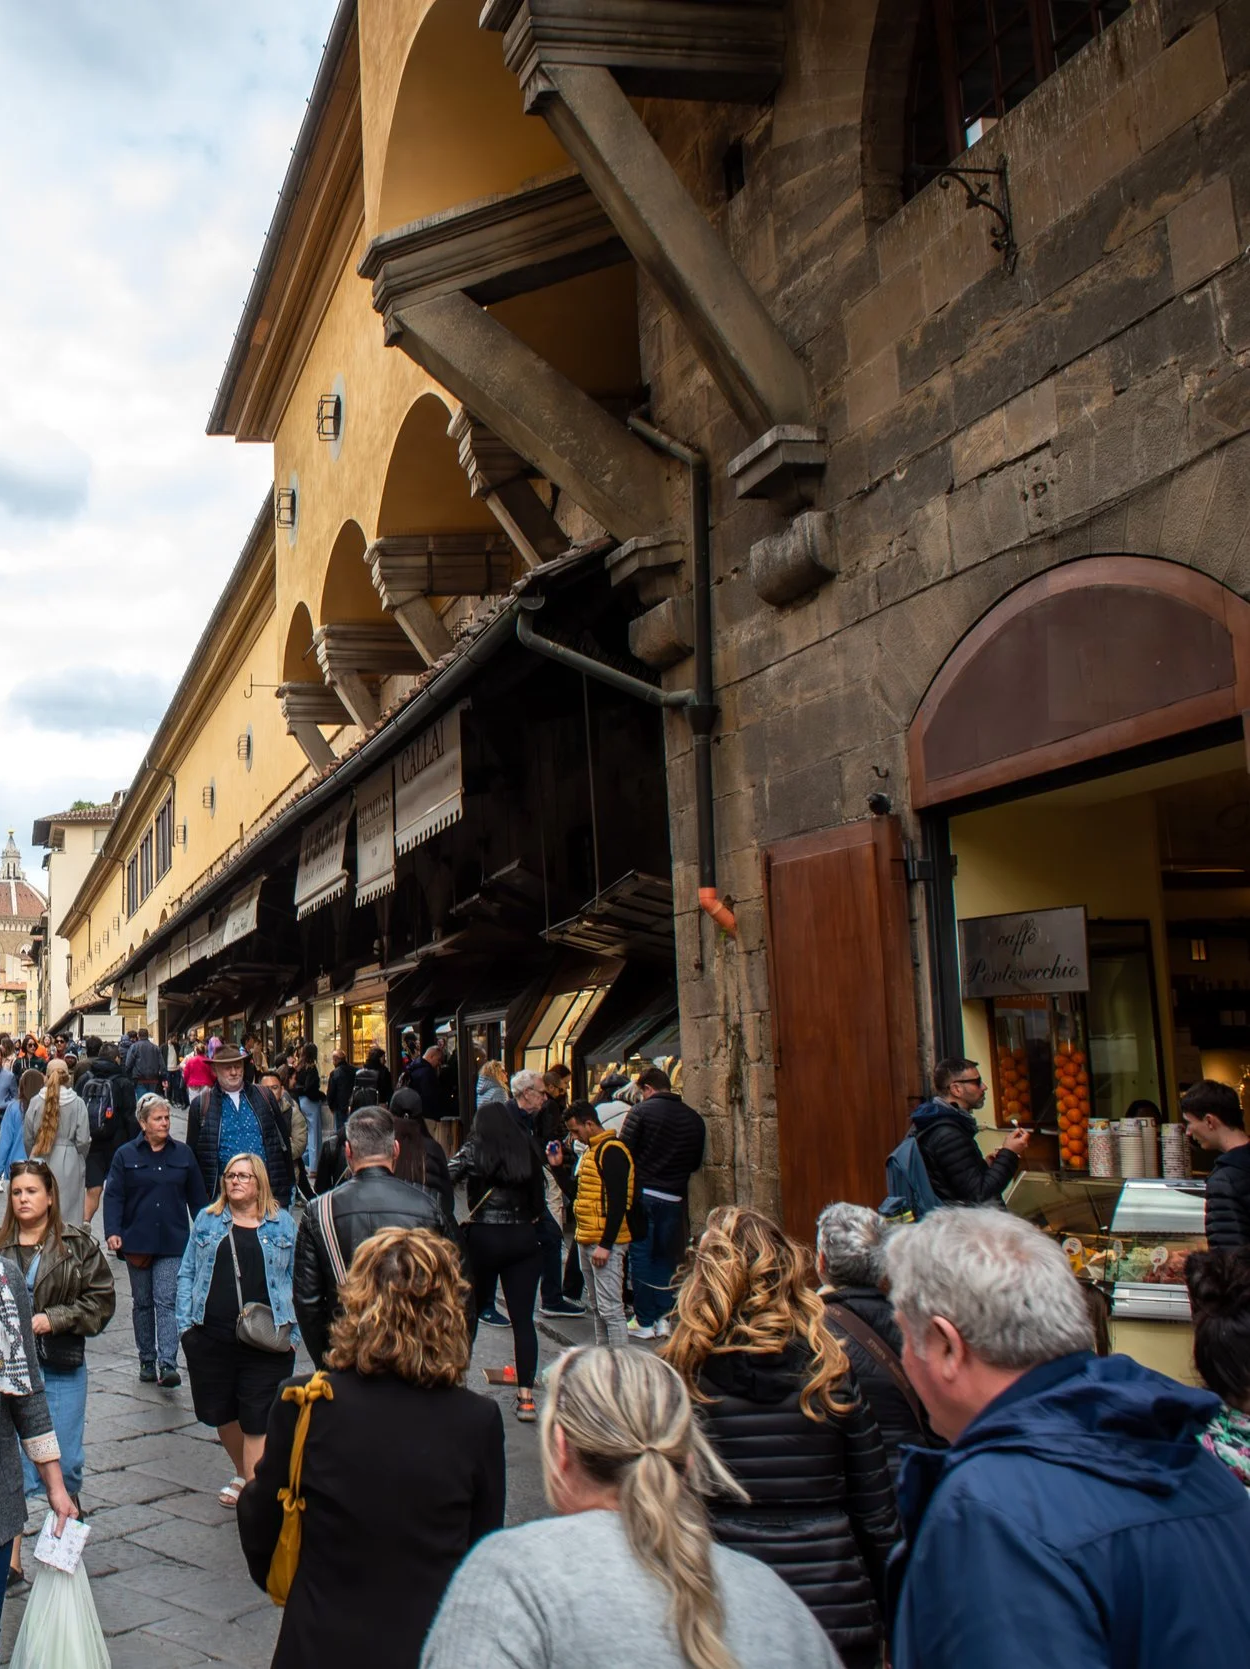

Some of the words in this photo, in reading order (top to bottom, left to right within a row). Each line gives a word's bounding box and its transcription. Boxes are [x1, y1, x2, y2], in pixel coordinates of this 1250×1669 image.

[401, 718, 445, 784] CALLAI
[359, 788, 390, 829] HUMILIS
[303, 809, 344, 867] U-BOAT
